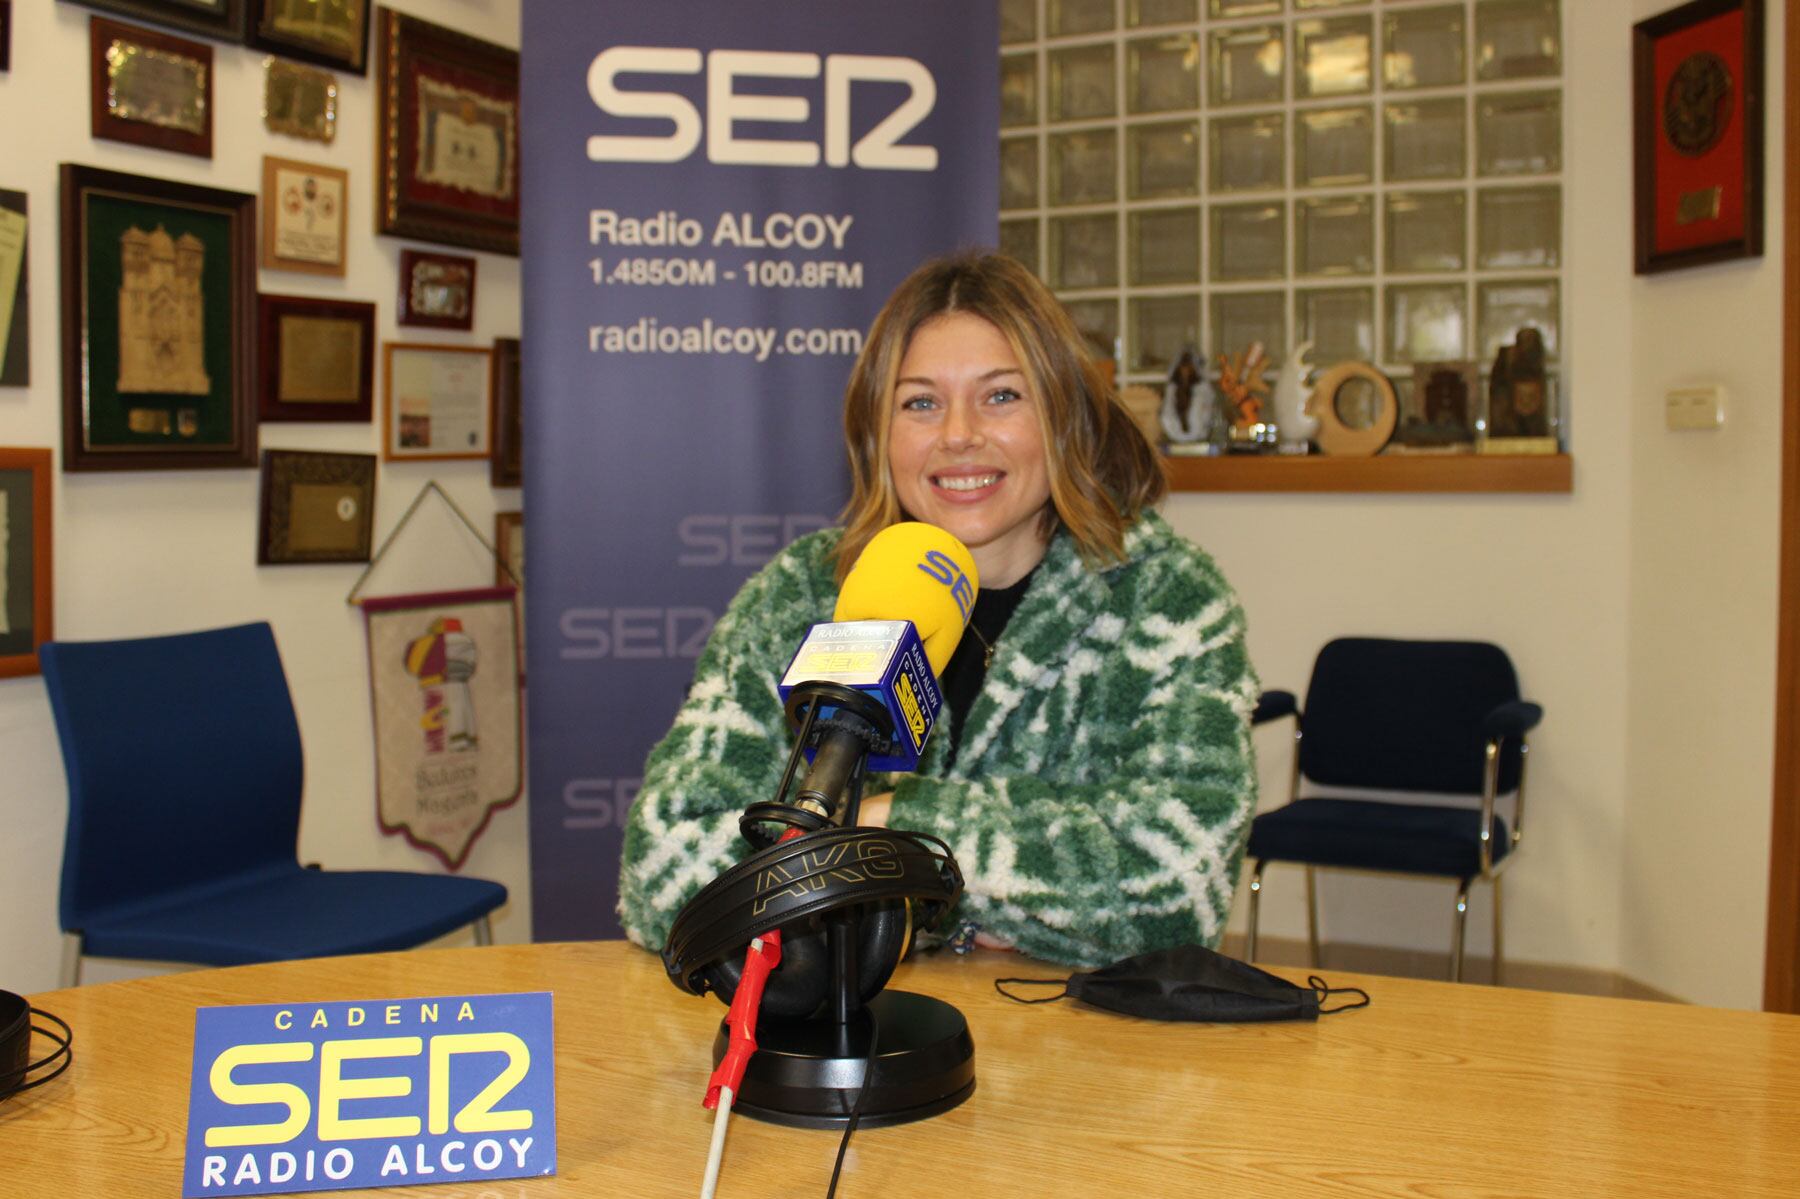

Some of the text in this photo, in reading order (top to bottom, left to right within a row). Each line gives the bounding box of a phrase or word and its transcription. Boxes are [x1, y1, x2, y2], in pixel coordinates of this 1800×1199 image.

[587, 45, 938, 171] SER
[589, 210, 853, 249] Radio ALCOY
[744, 261, 863, 289] 100.8FM
[588, 318, 864, 362] radioalcoy.com
[917, 550, 975, 627] SE
[904, 660, 931, 727] CADENA
[911, 643, 939, 708] RADIO ALCOY
[894, 672, 926, 748] SER
[753, 839, 905, 916] AKG
[275, 1001, 475, 1030] CADENA
[204, 1031, 534, 1148] SER
[202, 1136, 534, 1188] RADIO ALCOY
